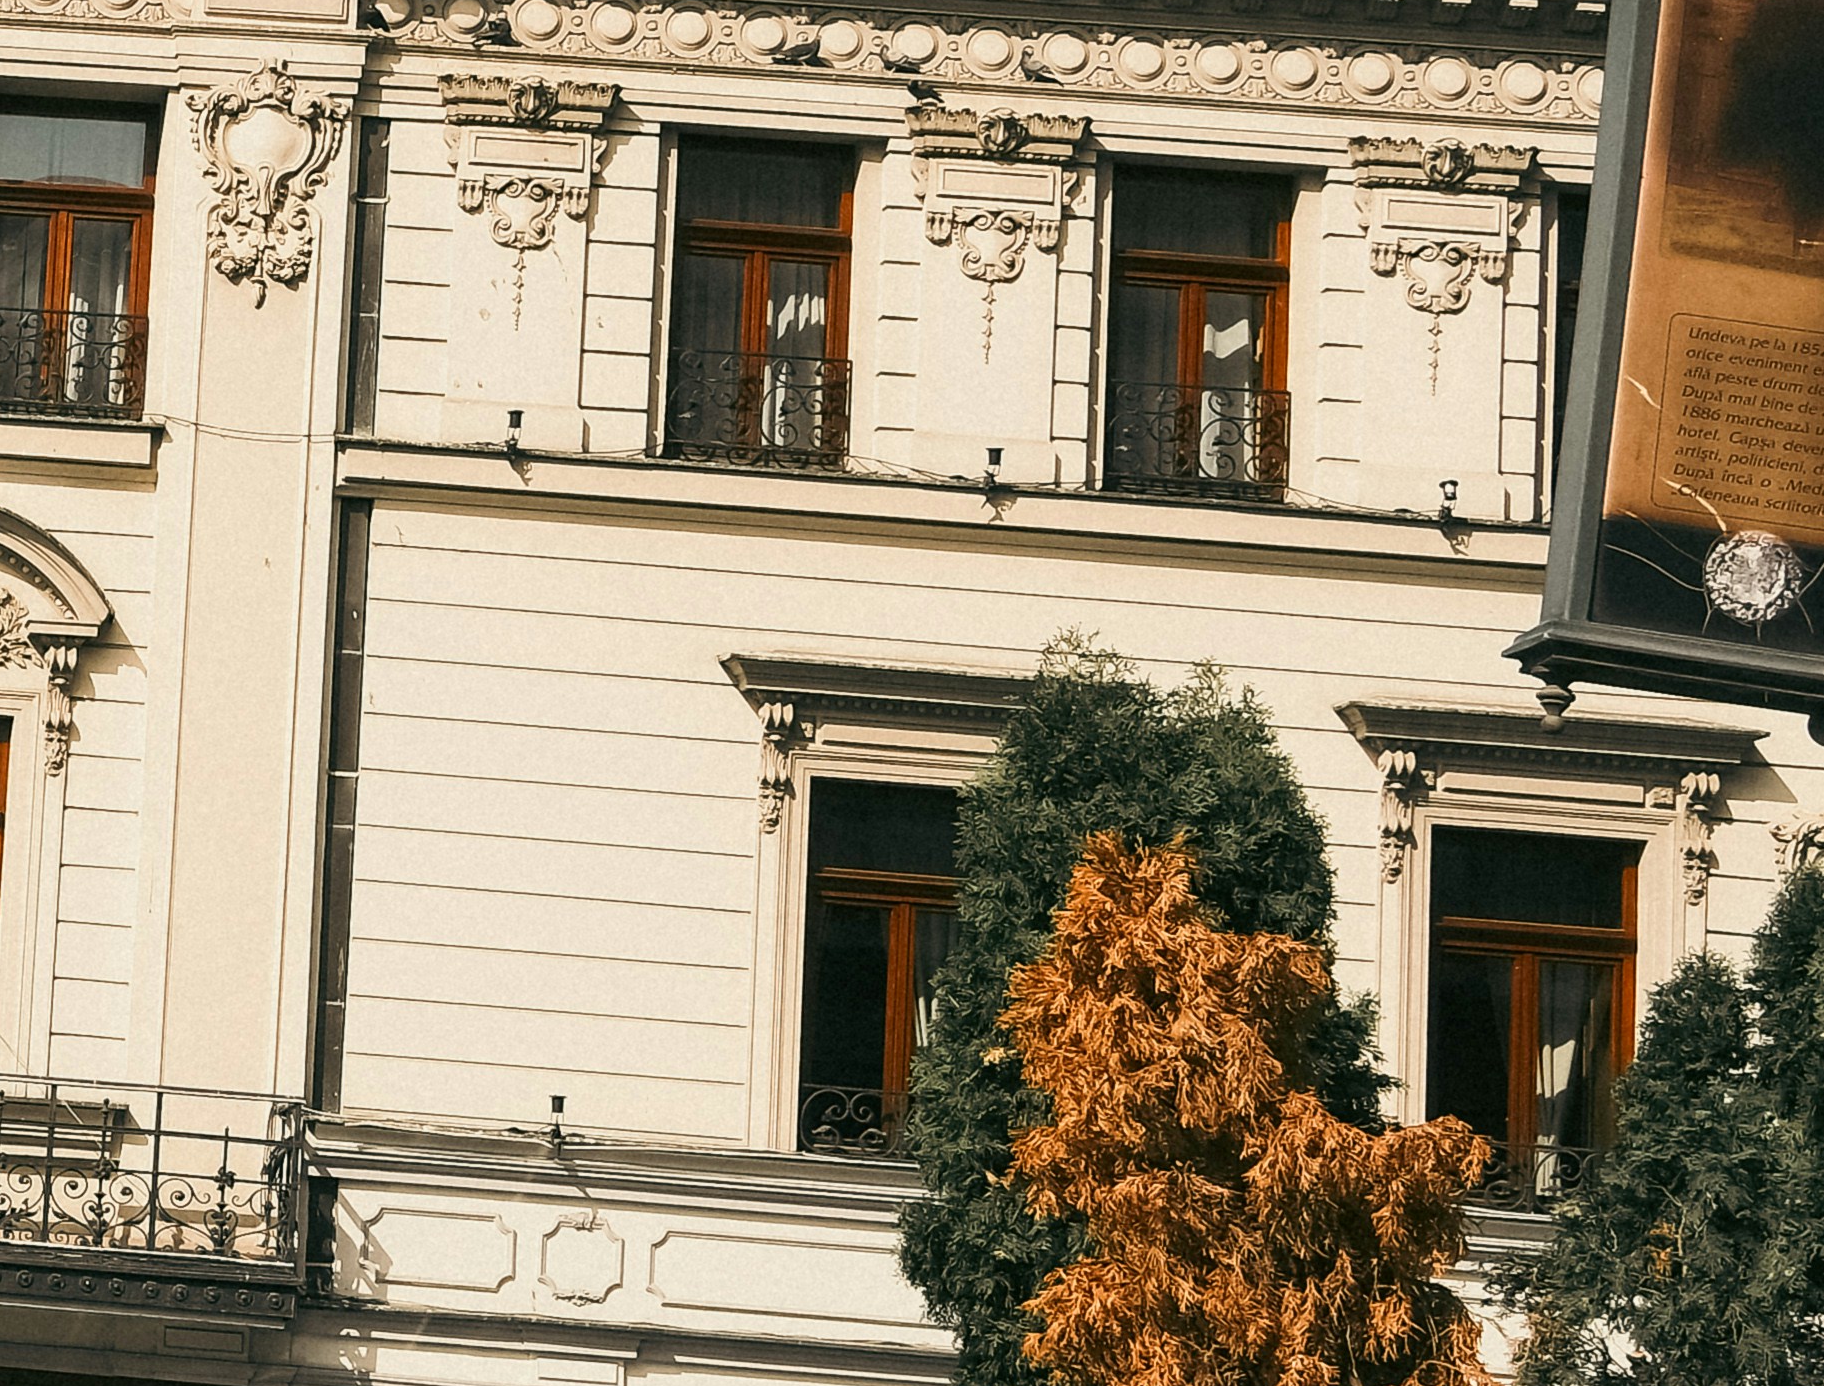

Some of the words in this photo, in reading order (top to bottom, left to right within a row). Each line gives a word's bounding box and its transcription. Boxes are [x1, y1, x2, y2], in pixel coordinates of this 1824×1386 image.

[1688, 326, 1746, 346] Undeva
[1748, 337, 1770, 350] pe
[1773, 338, 1786, 351] la
[1686, 348, 1724, 362] orice
[1728, 354, 1808, 375] eveniment
[1713, 371, 1759, 387] peste
[1763, 378, 1803, 394] drum
[1682, 384, 1723, 402] După
[1727, 393, 1756, 407] mai
[1760, 395, 1794, 412] bine
[1798, 401, 1819, 415] de
[1677, 423, 1720, 442] hotel.
[1682, 404, 1722, 422] 1886
[1725, 414, 1810, 434] marchează
[1673, 463, 1714, 482] După
[1760, 479, 1771, 489] o
[1778, 480, 1824, 497] „Med
